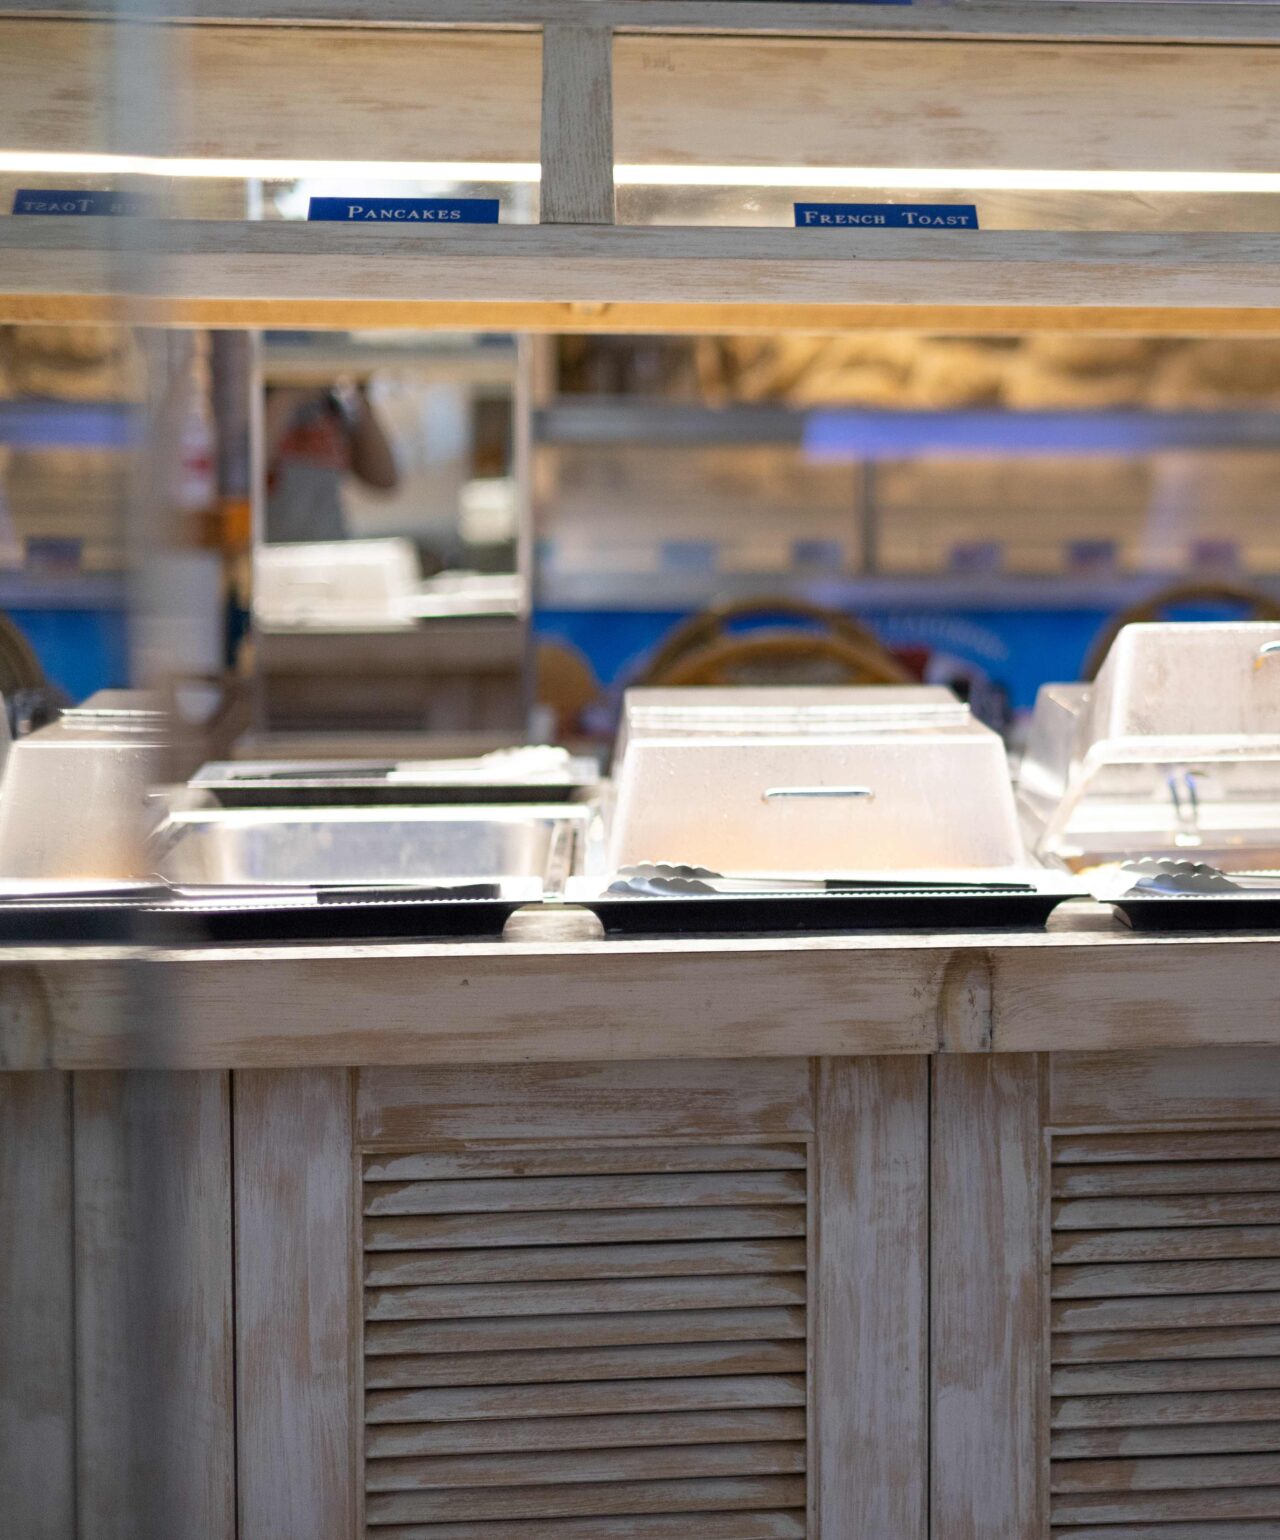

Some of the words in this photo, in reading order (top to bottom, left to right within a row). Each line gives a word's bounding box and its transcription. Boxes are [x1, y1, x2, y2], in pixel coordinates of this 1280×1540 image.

[347, 205, 461, 220] PANCAKES
[803, 211, 886, 225] FRENCH
[901, 212, 969, 225] TOAST
